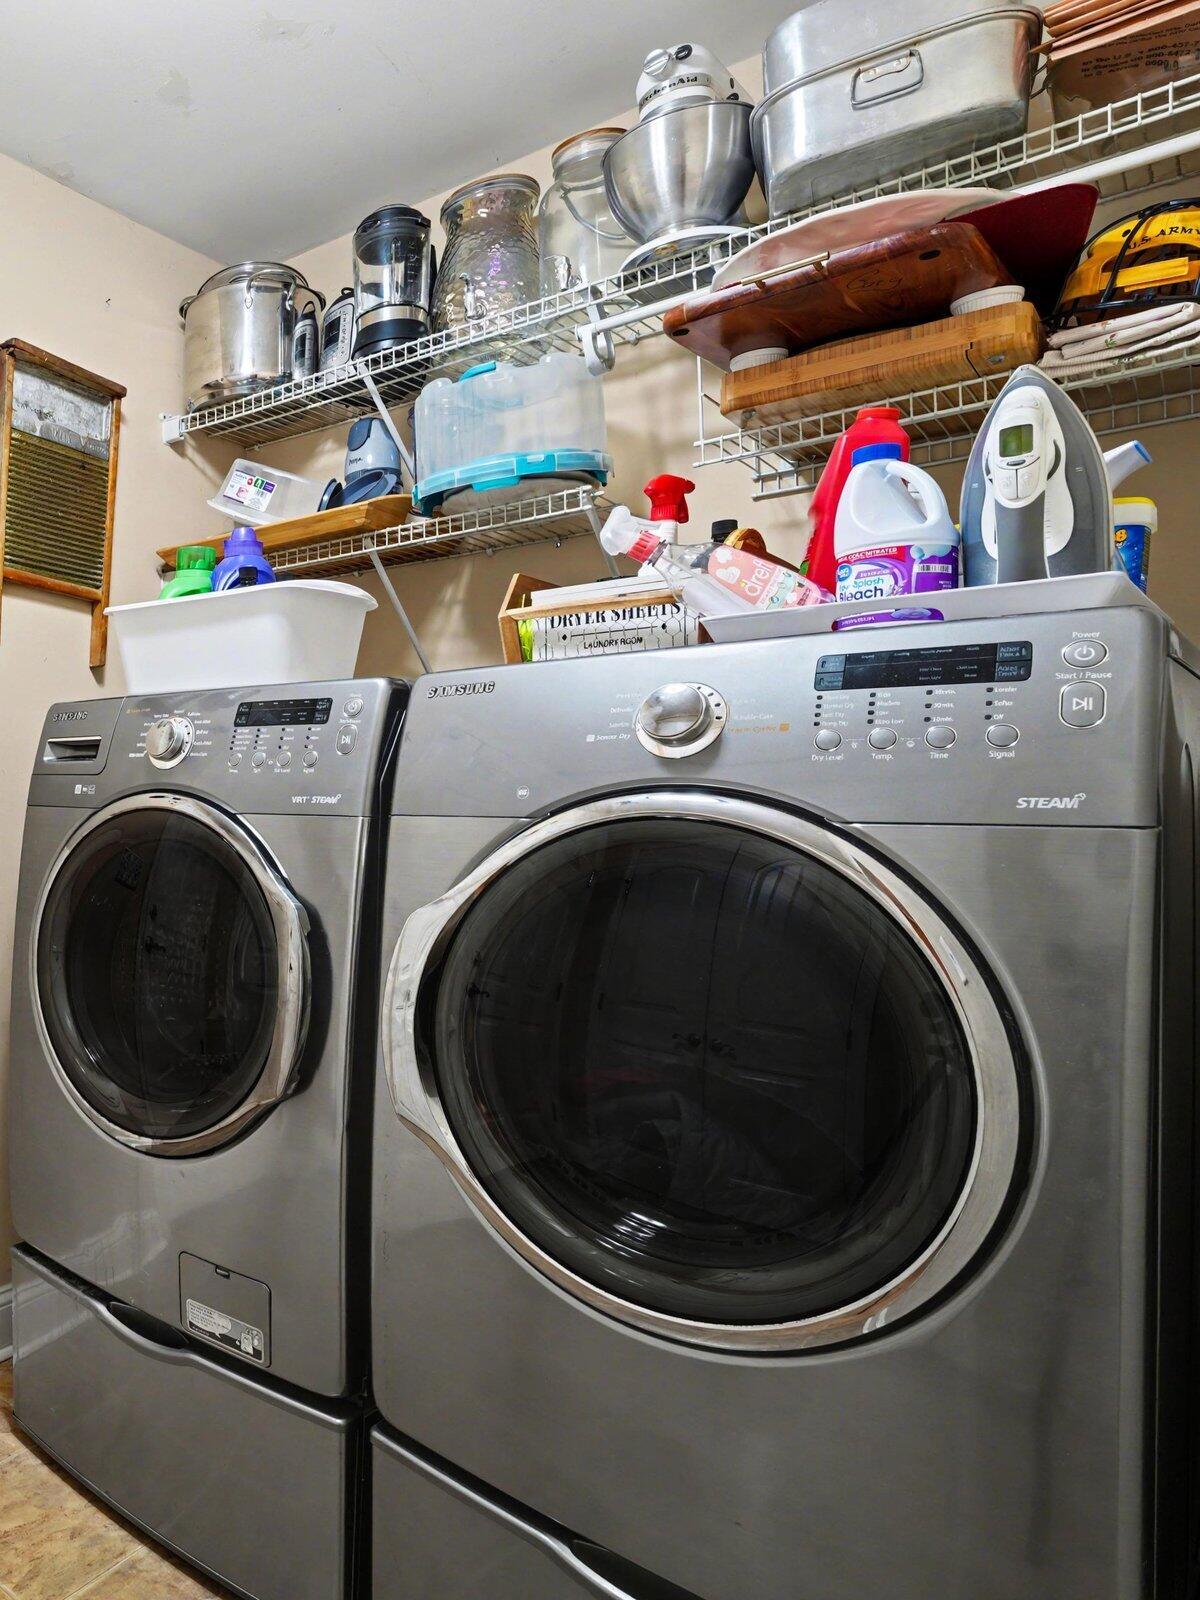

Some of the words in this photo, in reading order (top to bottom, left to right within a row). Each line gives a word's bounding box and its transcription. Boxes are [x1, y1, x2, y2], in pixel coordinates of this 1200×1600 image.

[549, 609, 607, 630] DRYER
[611, 602, 681, 623] SHEETS
[1072, 631, 1101, 639] Power
[1055, 672, 1077, 680] Start
[1085, 671, 1113, 679] Pause
[427, 681, 496, 699] SAMSUNG
[52, 711, 89, 722] SAMSUNG
[929, 751, 949, 759] Time
[988, 750, 1015, 760] Signal
[310, 794, 340, 804] STEAM
[1015, 796, 1083, 809] STEAM
